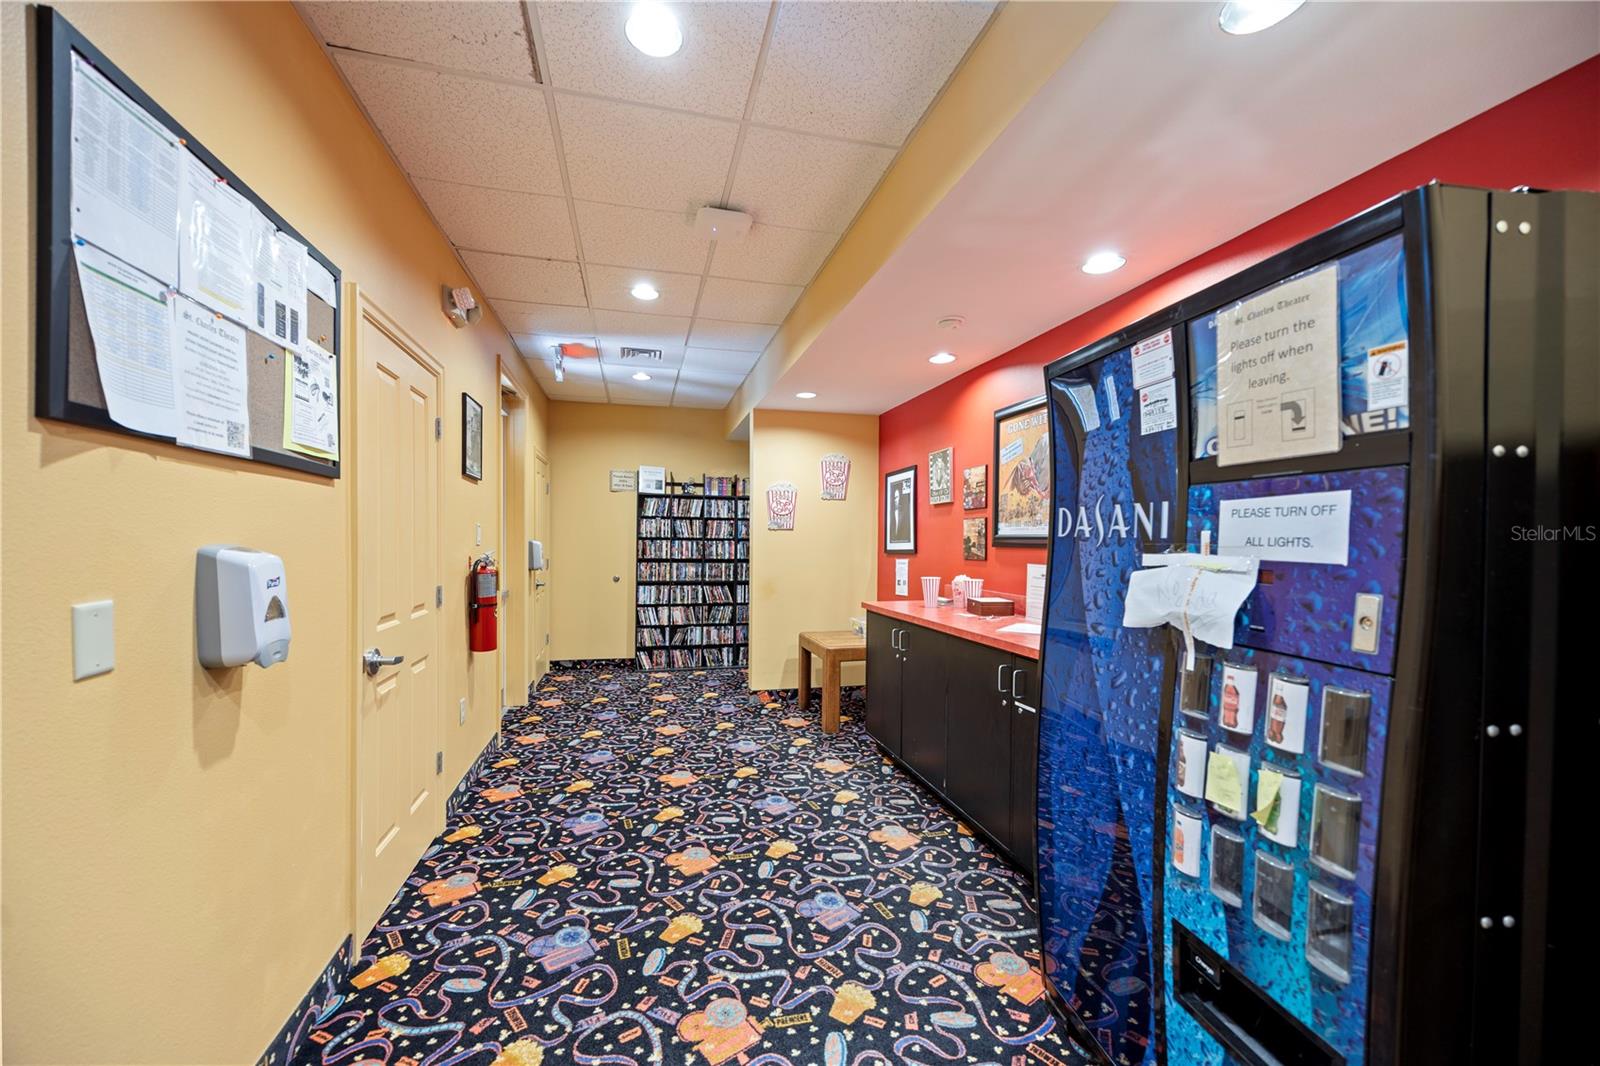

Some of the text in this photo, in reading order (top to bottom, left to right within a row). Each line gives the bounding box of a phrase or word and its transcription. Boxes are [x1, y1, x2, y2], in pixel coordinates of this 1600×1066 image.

[1276, 294, 1311, 310] Theater
[1230, 319, 1316, 352] Please turn the
[1231, 342, 1314, 374] lights off when
[1248, 372, 1290, 389] leaving.
[1231, 504, 1338, 519] PLEASE TURN OFF
[1057, 494, 1169, 547] DASANI
[1244, 536, 1315, 549] ALL LIGHTS.
